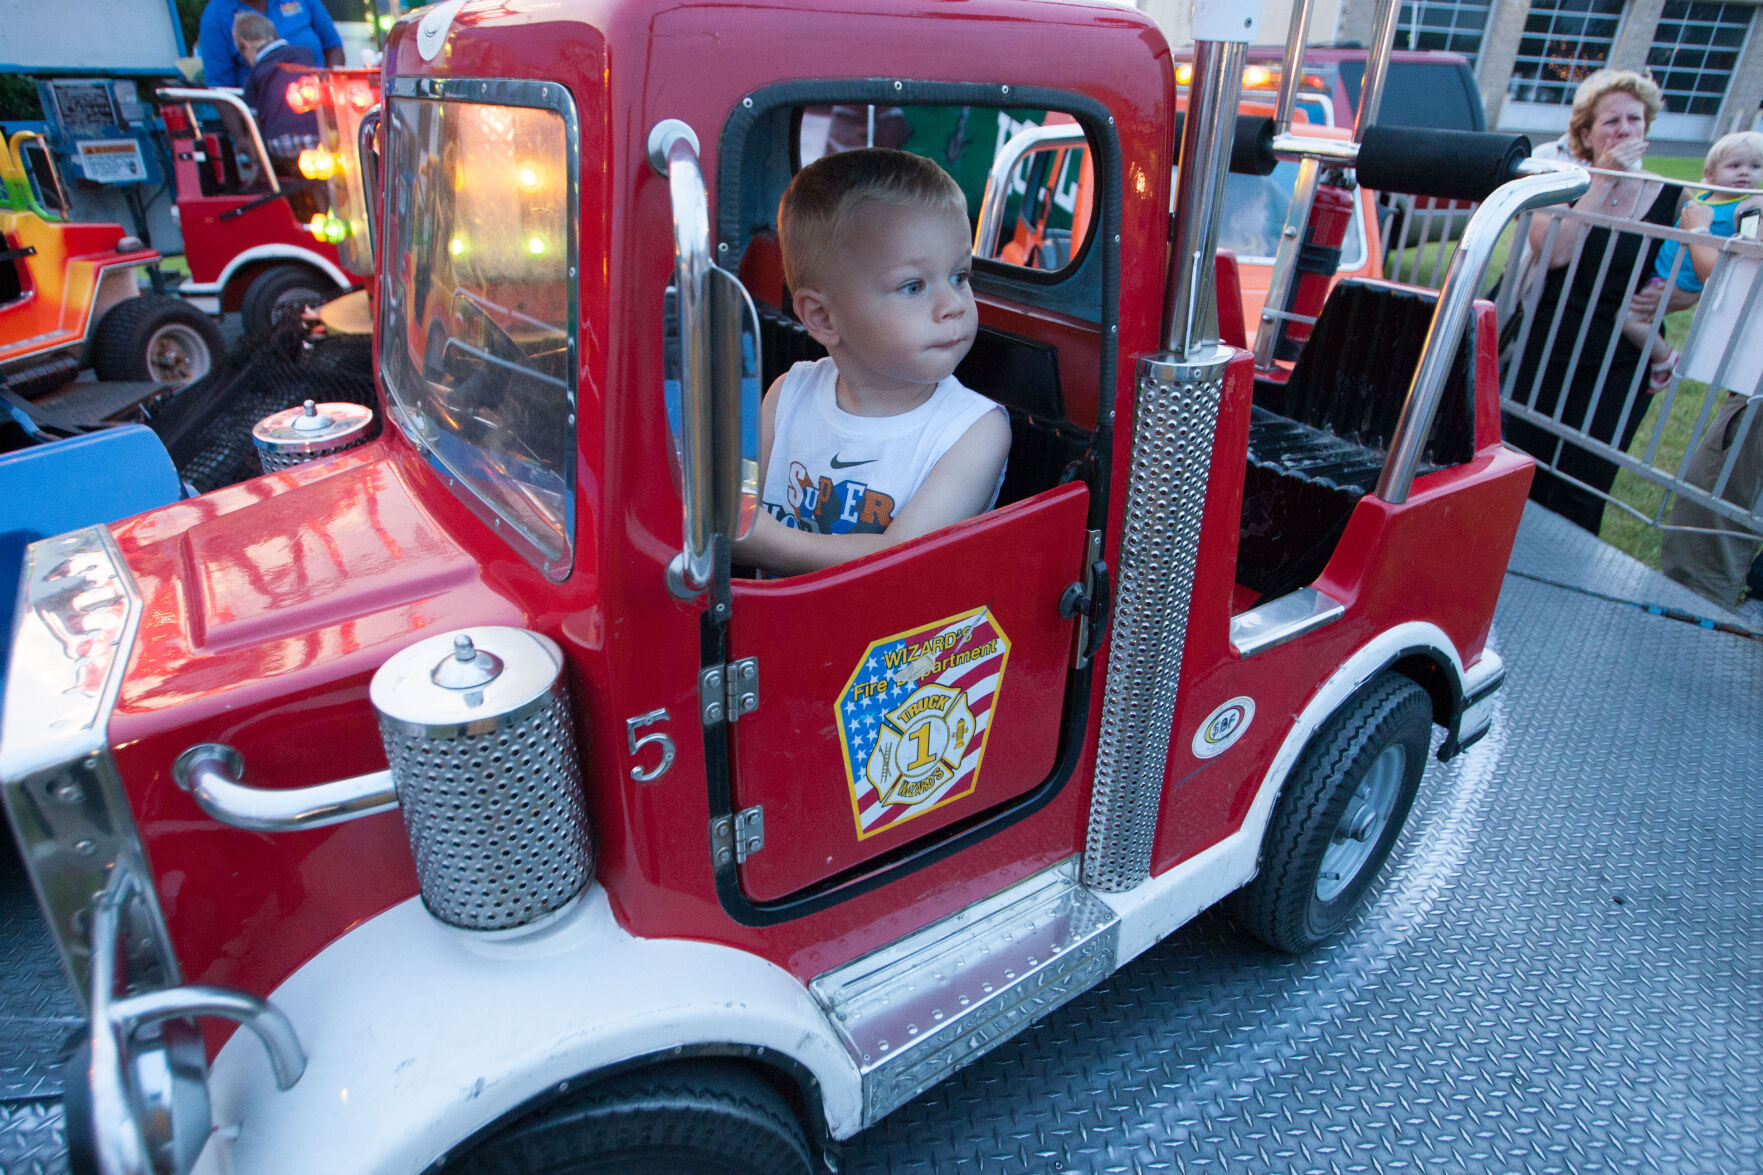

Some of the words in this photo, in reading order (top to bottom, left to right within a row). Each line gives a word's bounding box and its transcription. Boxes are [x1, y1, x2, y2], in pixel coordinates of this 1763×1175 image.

[788, 461, 895, 526] SUPER
[853, 678, 888, 701] Fire
[896, 639, 998, 688] partment
[884, 626, 973, 669] WIZARD'S
[898, 695, 951, 723] TRUCK
[626, 707, 676, 782] 5
[907, 722, 937, 771] 1
[897, 767, 945, 798] WIZARD'S
